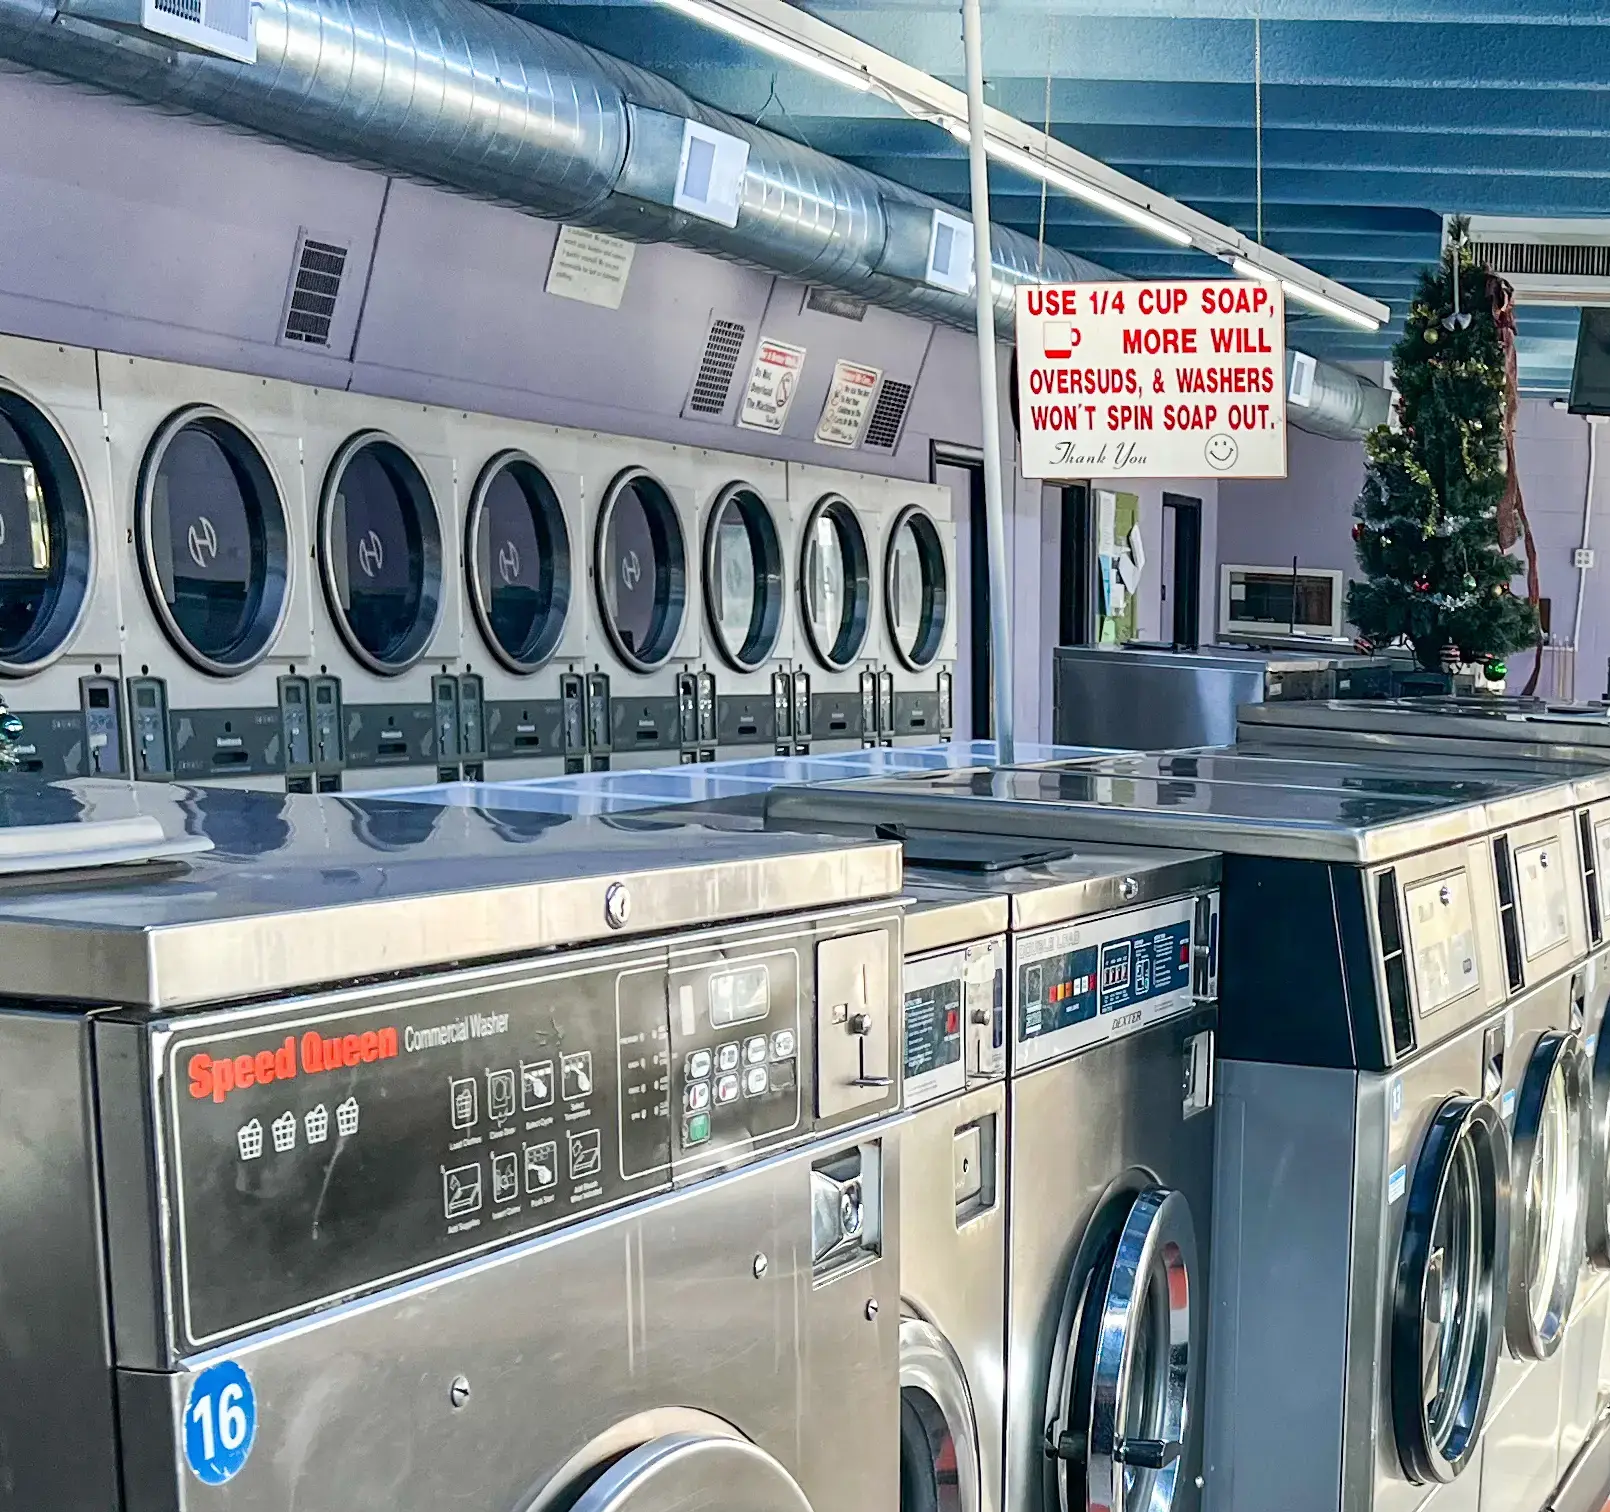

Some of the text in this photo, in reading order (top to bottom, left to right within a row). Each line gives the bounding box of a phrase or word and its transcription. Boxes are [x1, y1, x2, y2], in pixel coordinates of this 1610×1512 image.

[1027, 287, 1275, 318] USE 1/4 CUP SOAP,
[1123, 327, 1272, 354] MORE WILL
[1030, 367, 1274, 398] OVERSUDS, & WASHERS
[1031, 404, 1275, 431] WON'T SPIN SOAP OUT.
[1049, 441, 1148, 470] Thank You
[404, 1010, 509, 1052] Commercial Washer
[1111, 1010, 1142, 1030] DEXTER
[188, 1027, 399, 1104] Speed Queen
[193, 1383, 247, 1460] 16
